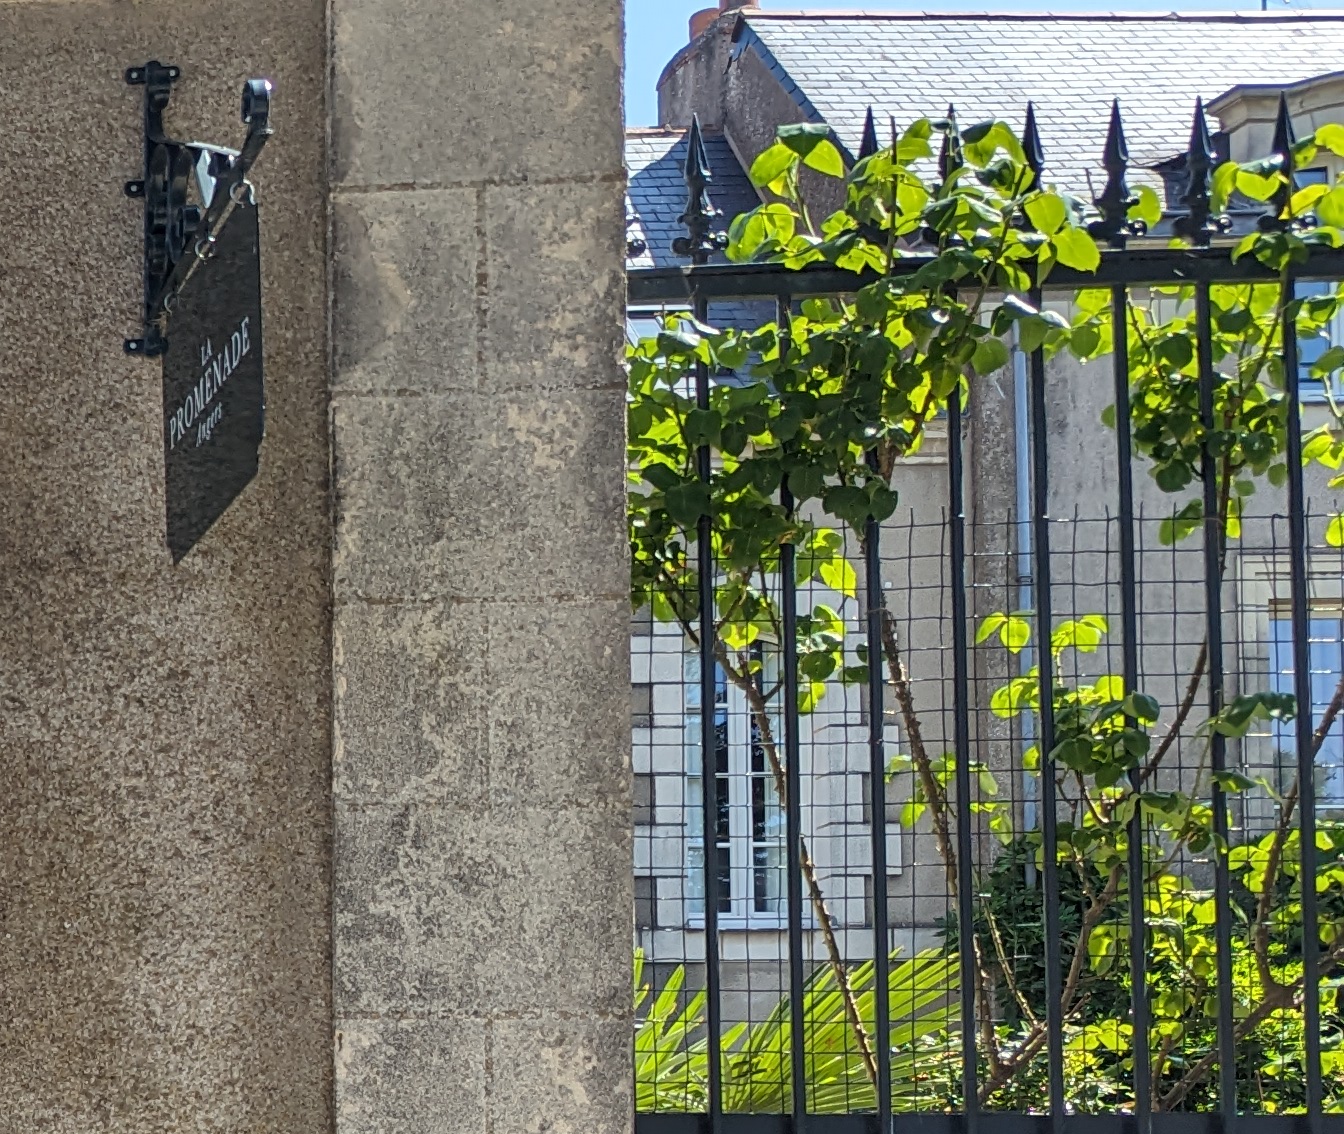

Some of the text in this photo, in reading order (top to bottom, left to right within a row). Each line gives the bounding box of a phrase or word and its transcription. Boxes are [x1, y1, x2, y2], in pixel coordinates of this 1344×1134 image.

[201, 338, 212, 367] LA
[170, 316, 250, 450] PROMENADE
[196, 401, 222, 447] Angers
